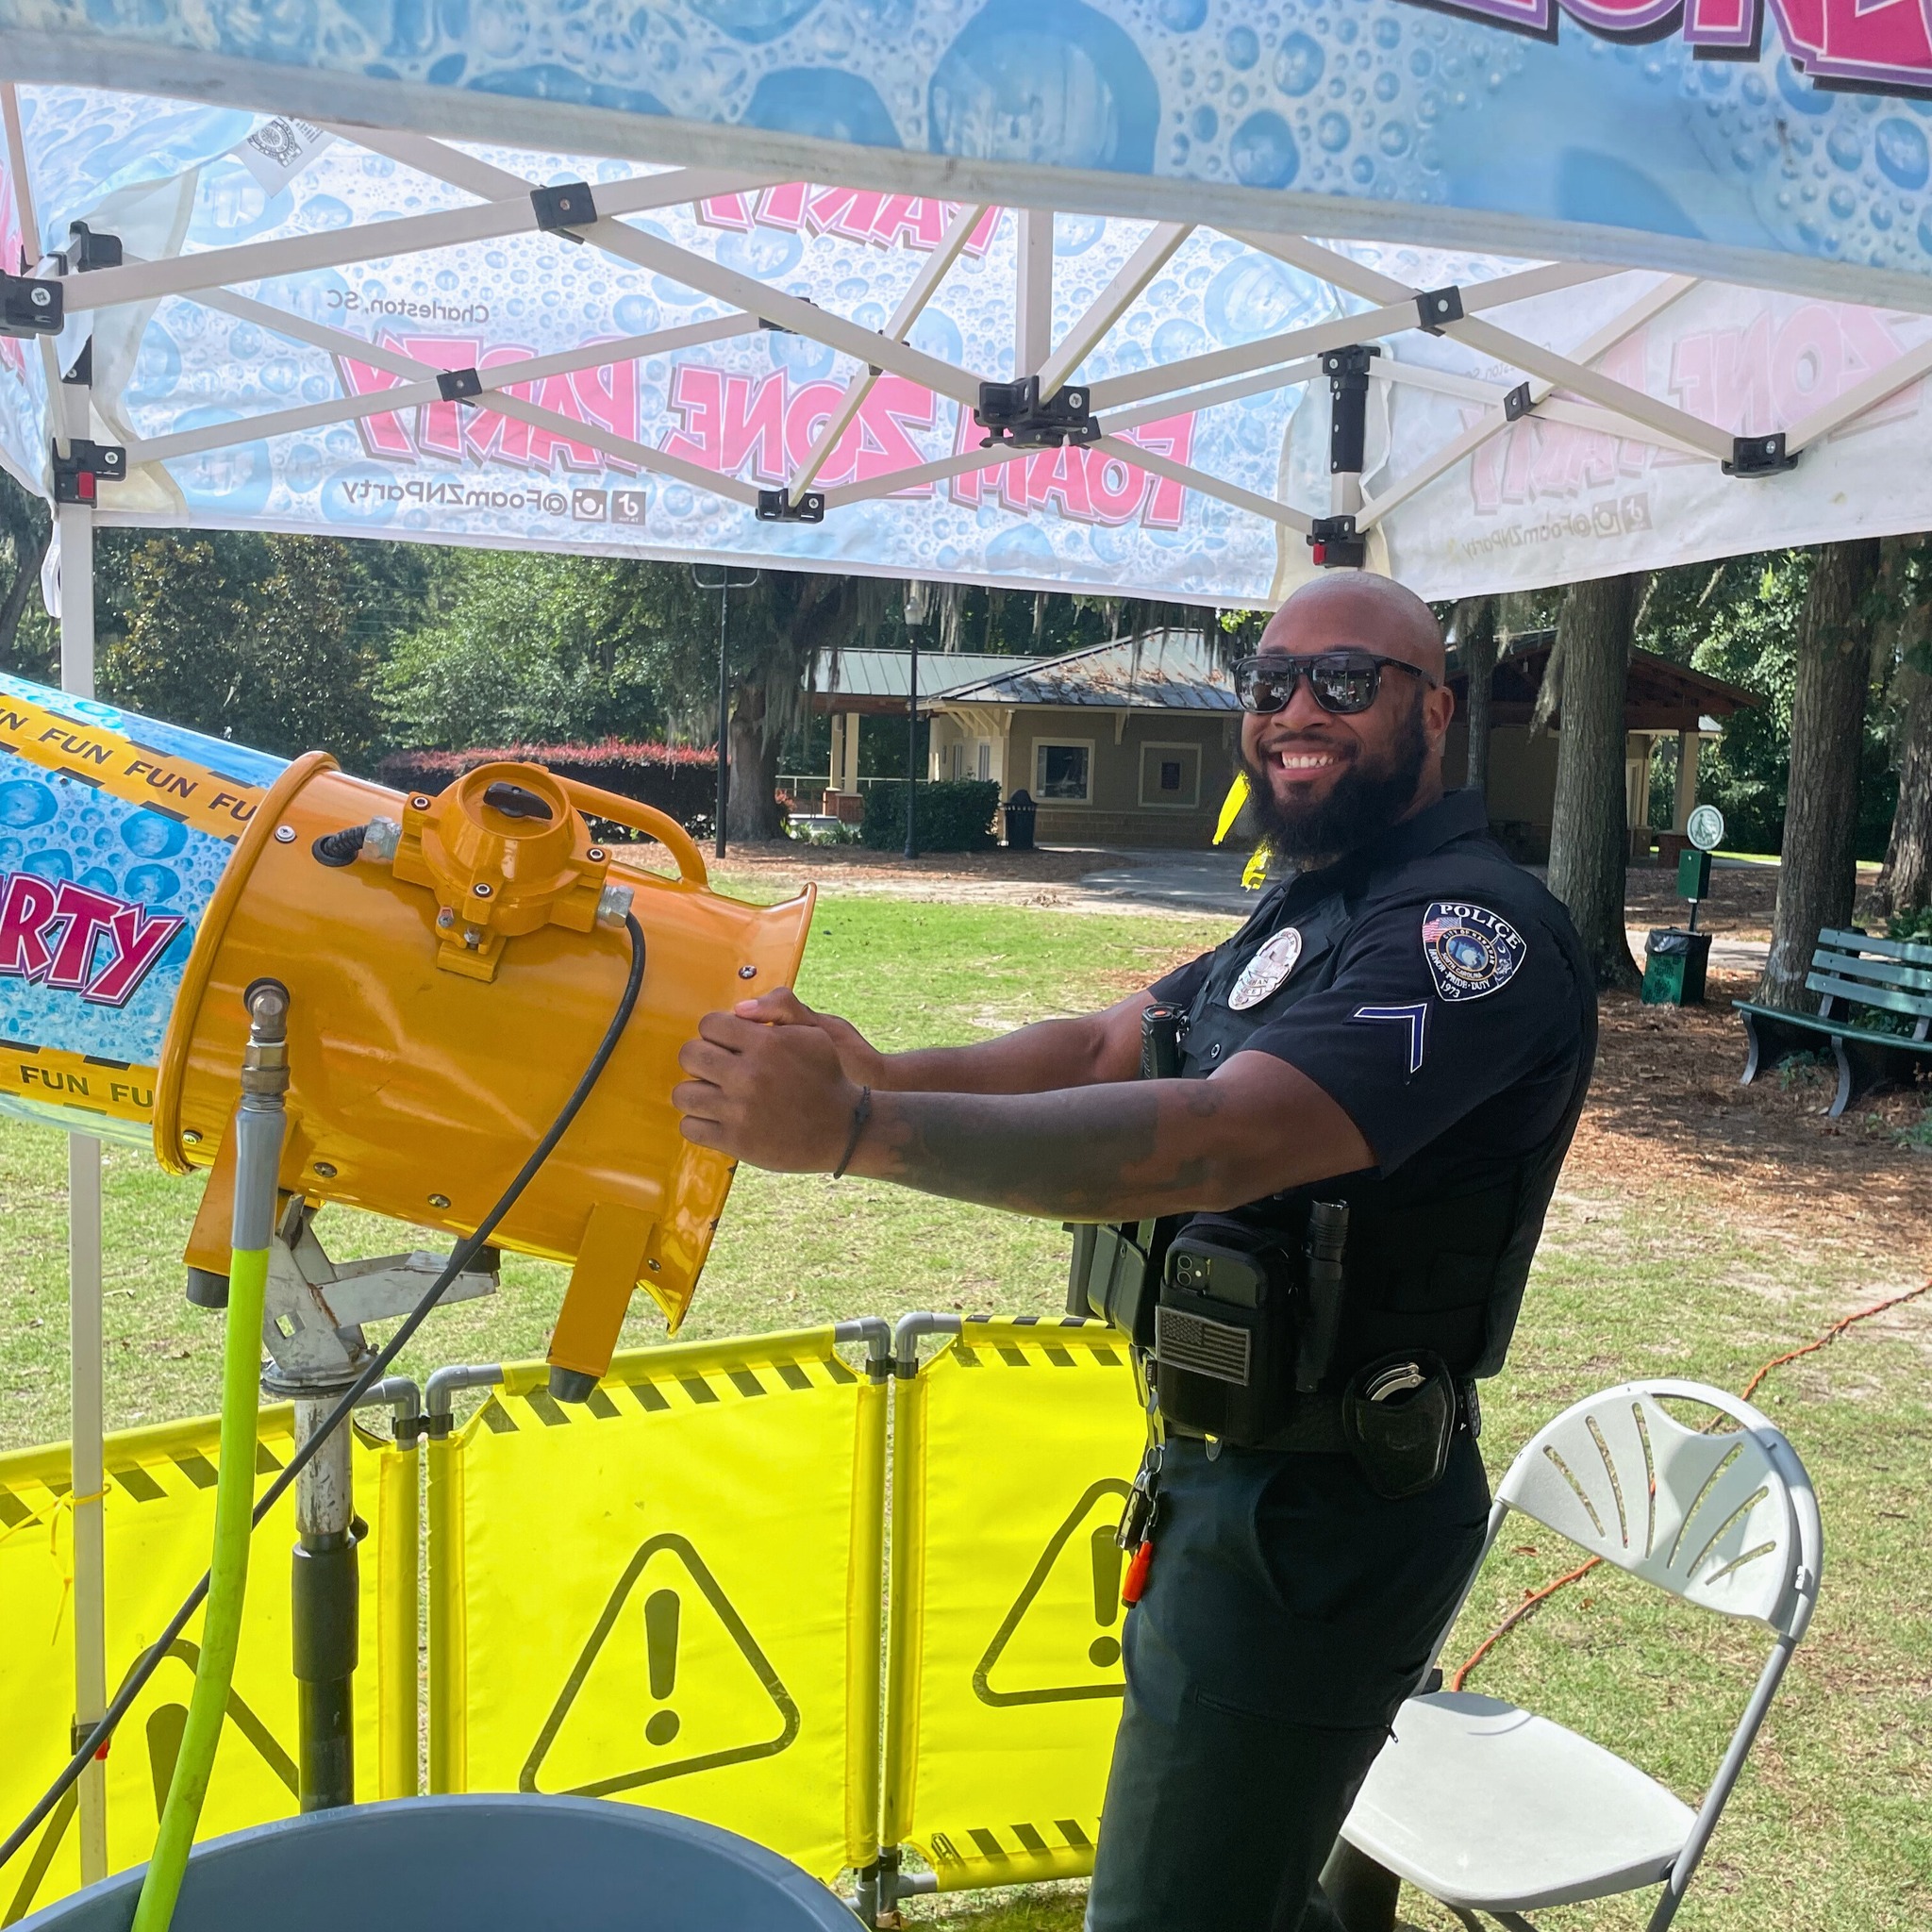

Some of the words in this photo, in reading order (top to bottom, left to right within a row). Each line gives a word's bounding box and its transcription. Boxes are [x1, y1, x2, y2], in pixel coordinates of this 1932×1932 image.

[38, 726, 114, 765] FUN
[124, 759, 199, 799] FUN
[0, 872, 186, 1009] RTY
[1439, 904, 1522, 949] POLICE
[1440, 980, 1461, 998] 1973
[1445, 971, 1468, 990] PRIDE
[1470, 978, 1491, 991] DUTY
[20, 1065, 90, 1096] FUN
